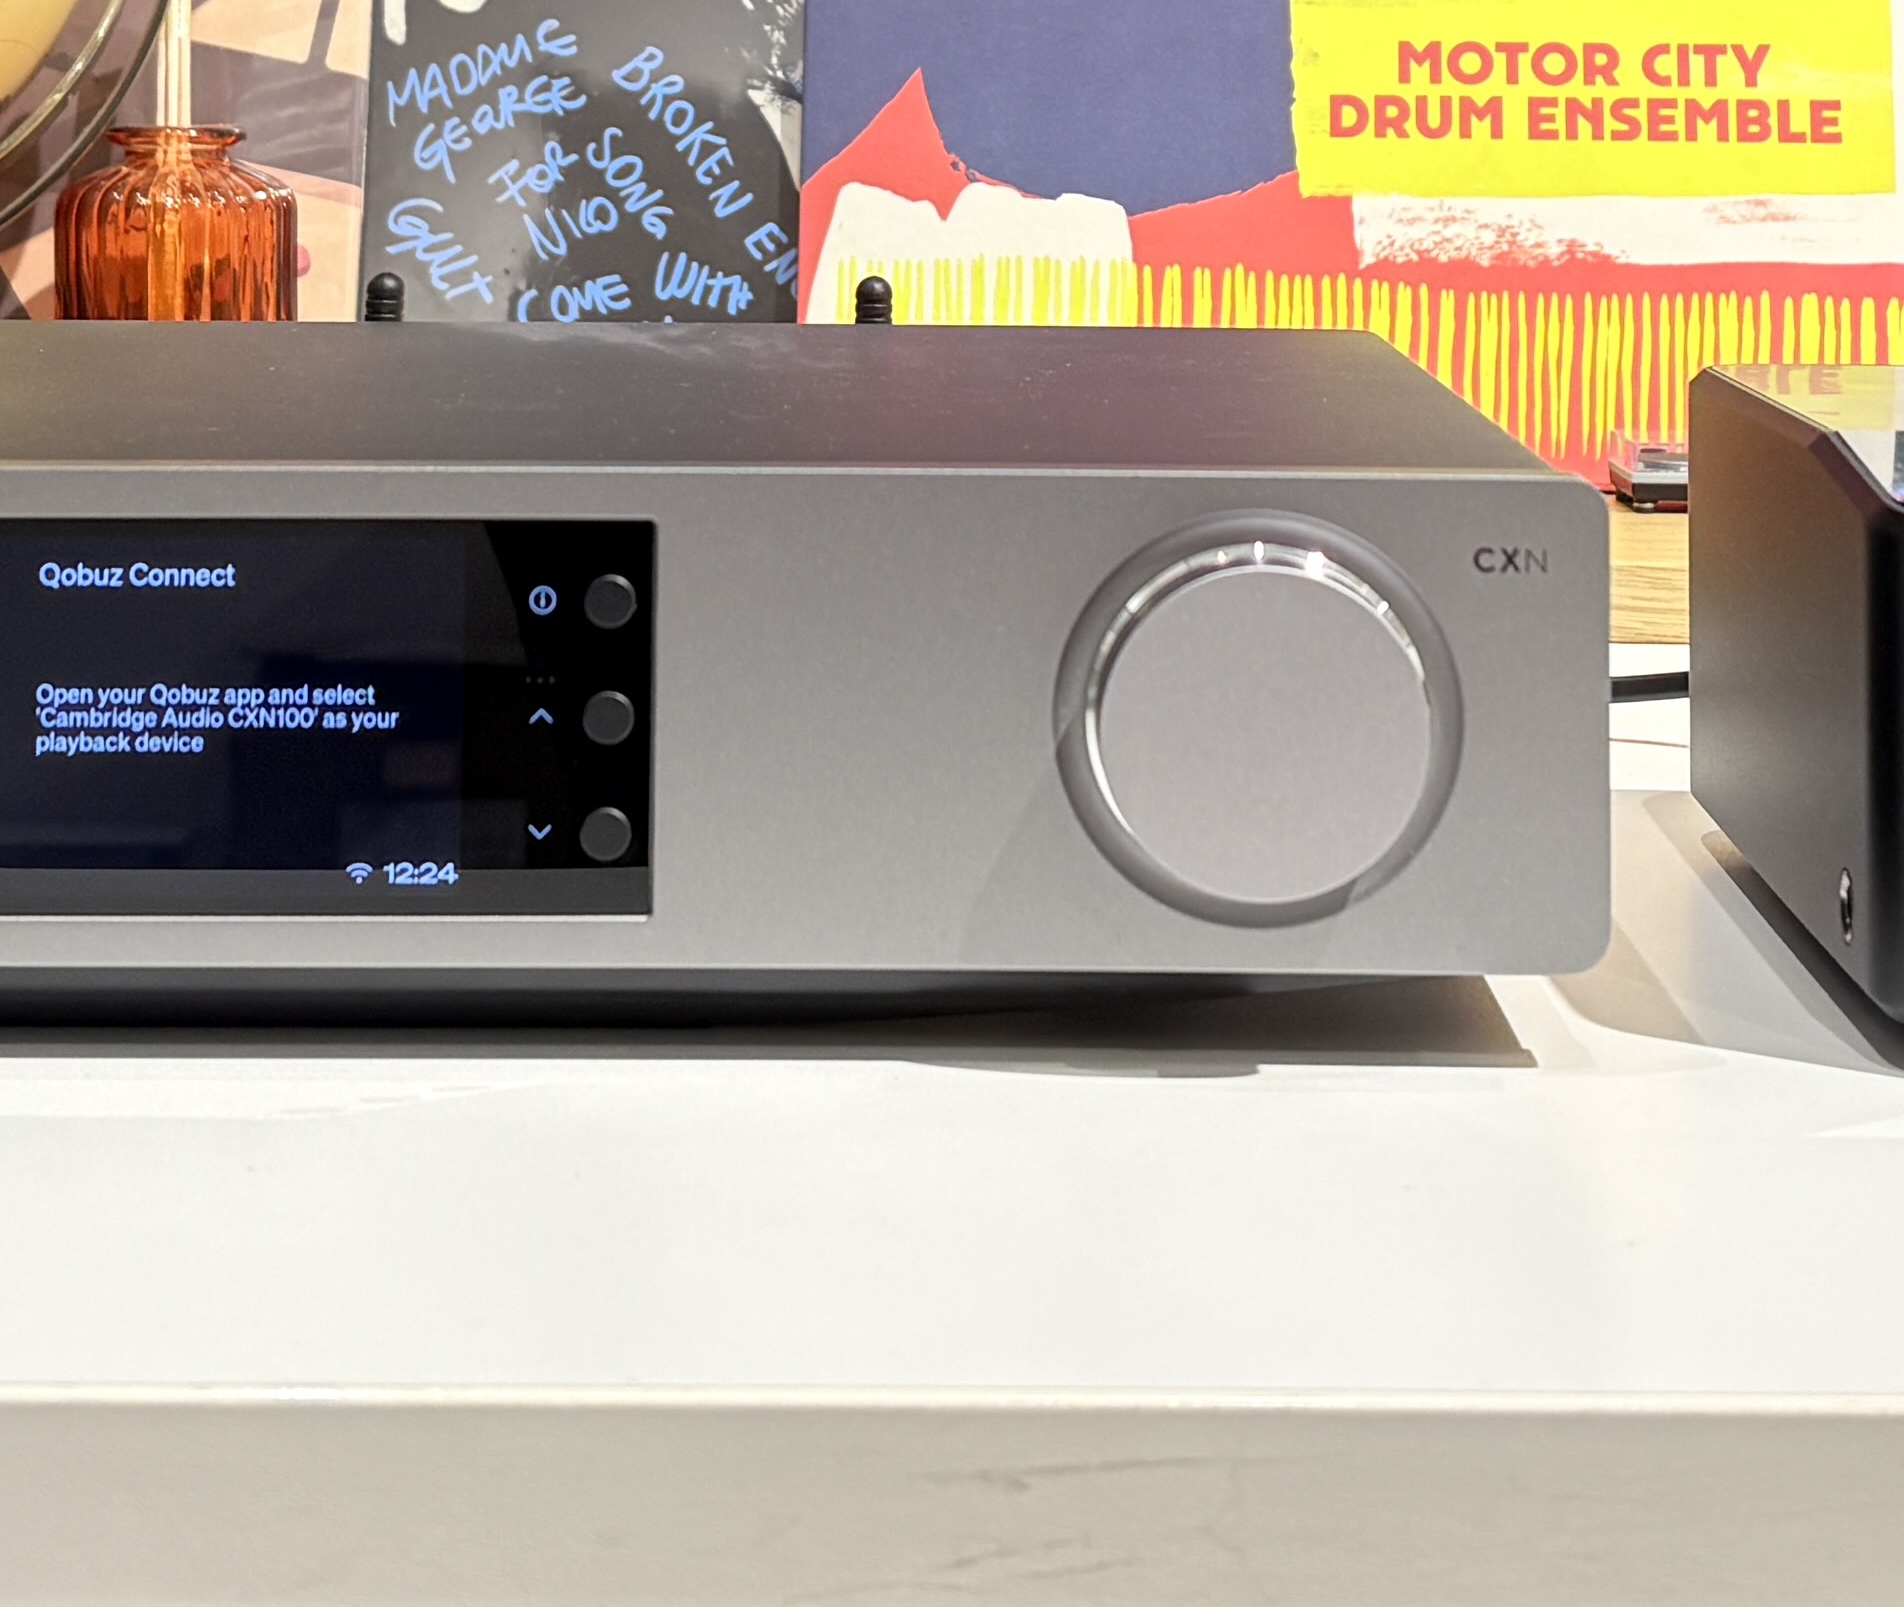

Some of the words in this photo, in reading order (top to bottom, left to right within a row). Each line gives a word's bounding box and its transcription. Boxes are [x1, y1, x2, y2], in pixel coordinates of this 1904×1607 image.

[1398, 41, 1621, 86] MOTOR
[1641, 43, 1772, 88] CITY
[611, 45, 754, 219] BROKEN
[1328, 95, 1504, 140] DRUM
[1527, 97, 1843, 144] ENSEMBLE
[487, 140, 579, 208] FOR
[585, 126, 674, 241] SONG
[1473, 547, 1549, 574] CXN
[38, 561, 124, 592] Qobuz
[128, 561, 236, 589] Connect
[35, 683, 94, 708] Open
[97, 687, 146, 710] your
[149, 683, 220, 708] Qobuz
[223, 687, 264, 711] app
[267, 684, 309, 705] and
[312, 684, 376, 706] select
[35, 707, 158, 732] 'Cambridge
[162, 707, 225, 729] Audio
[228, 707, 319, 729] CXN100'
[322, 711, 346, 729] as
[349, 711, 400, 734] your
[35, 731, 131, 756] playback
[134, 731, 204, 754] device
[382, 861, 458, 885] 12:24
